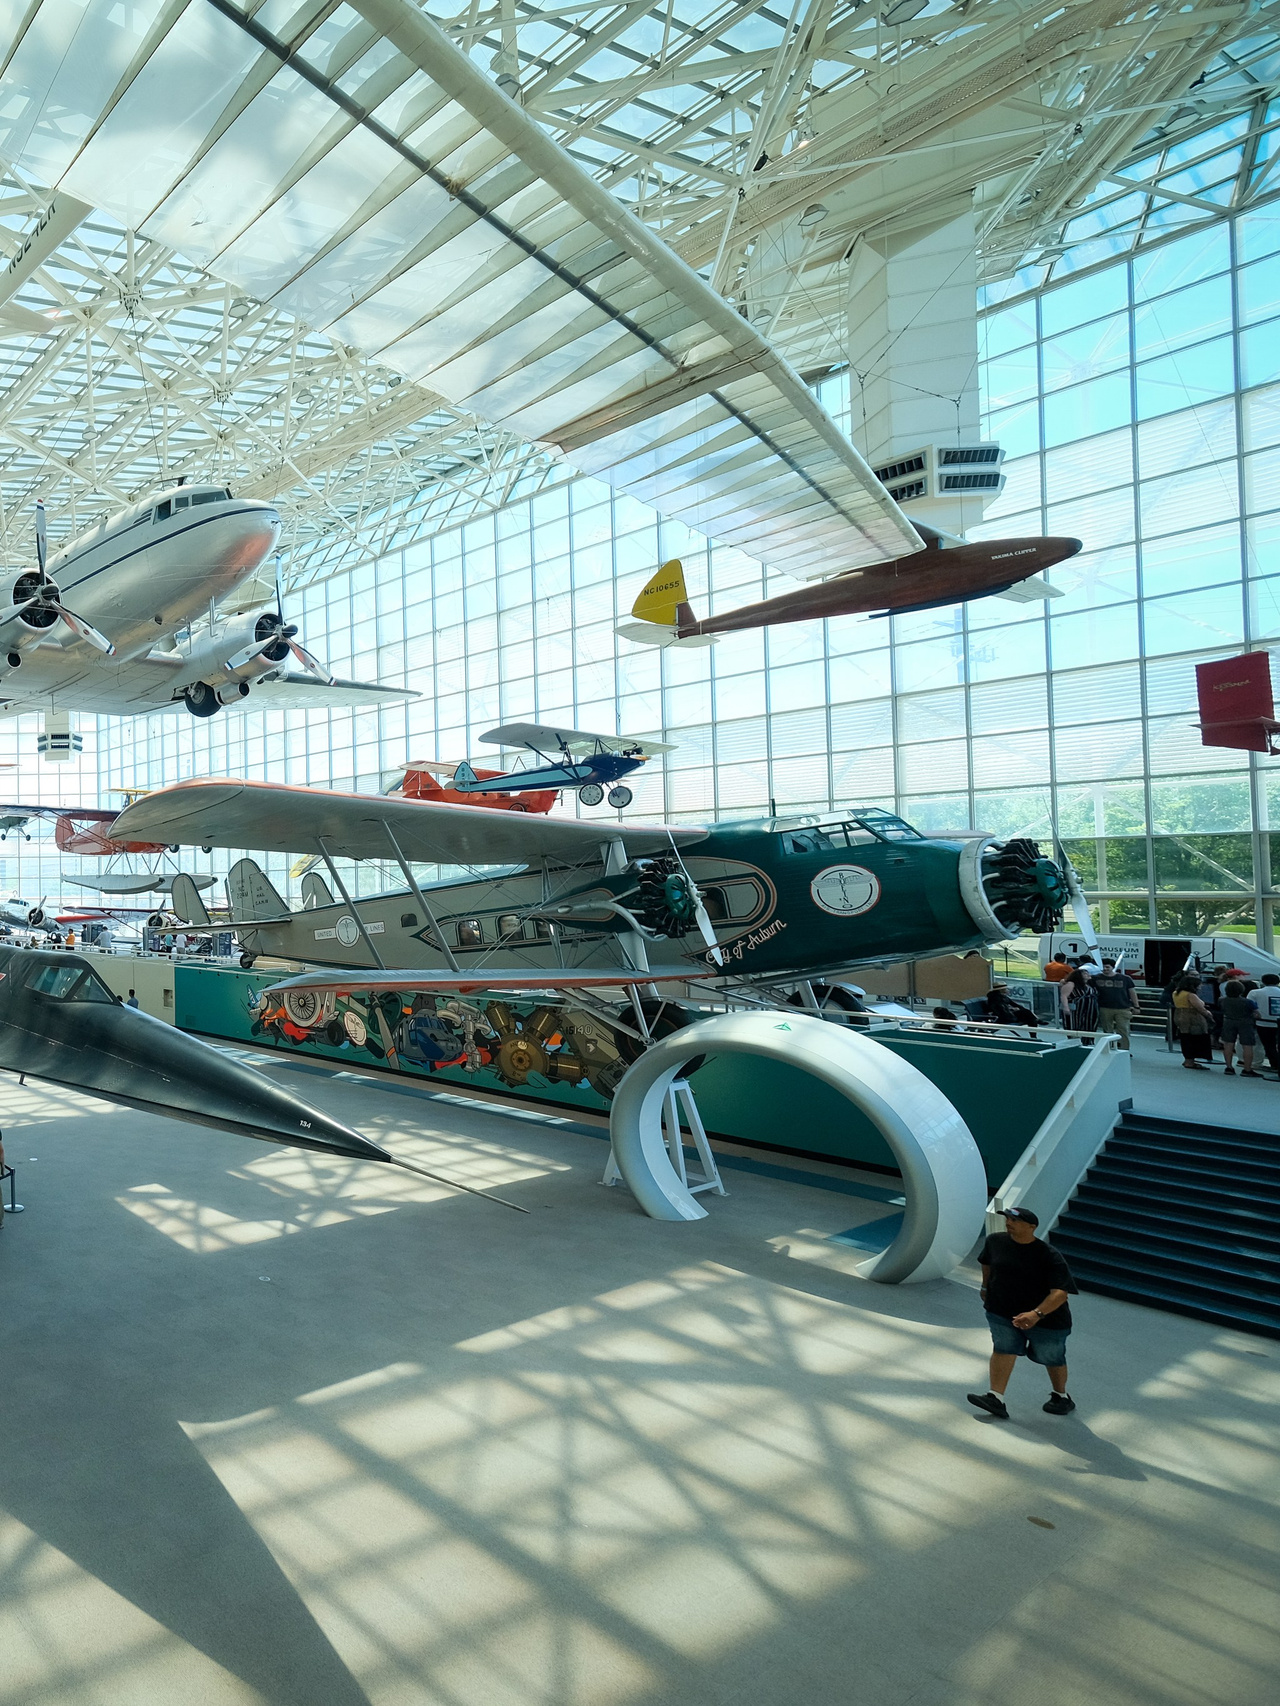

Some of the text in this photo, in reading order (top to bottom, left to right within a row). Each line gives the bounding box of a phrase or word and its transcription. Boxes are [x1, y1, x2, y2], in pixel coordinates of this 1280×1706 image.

[705, 919, 787, 964] Cty of Auburn
[1068, 943, 1078, 953] 1
[300, 1120, 311, 1128] 134
